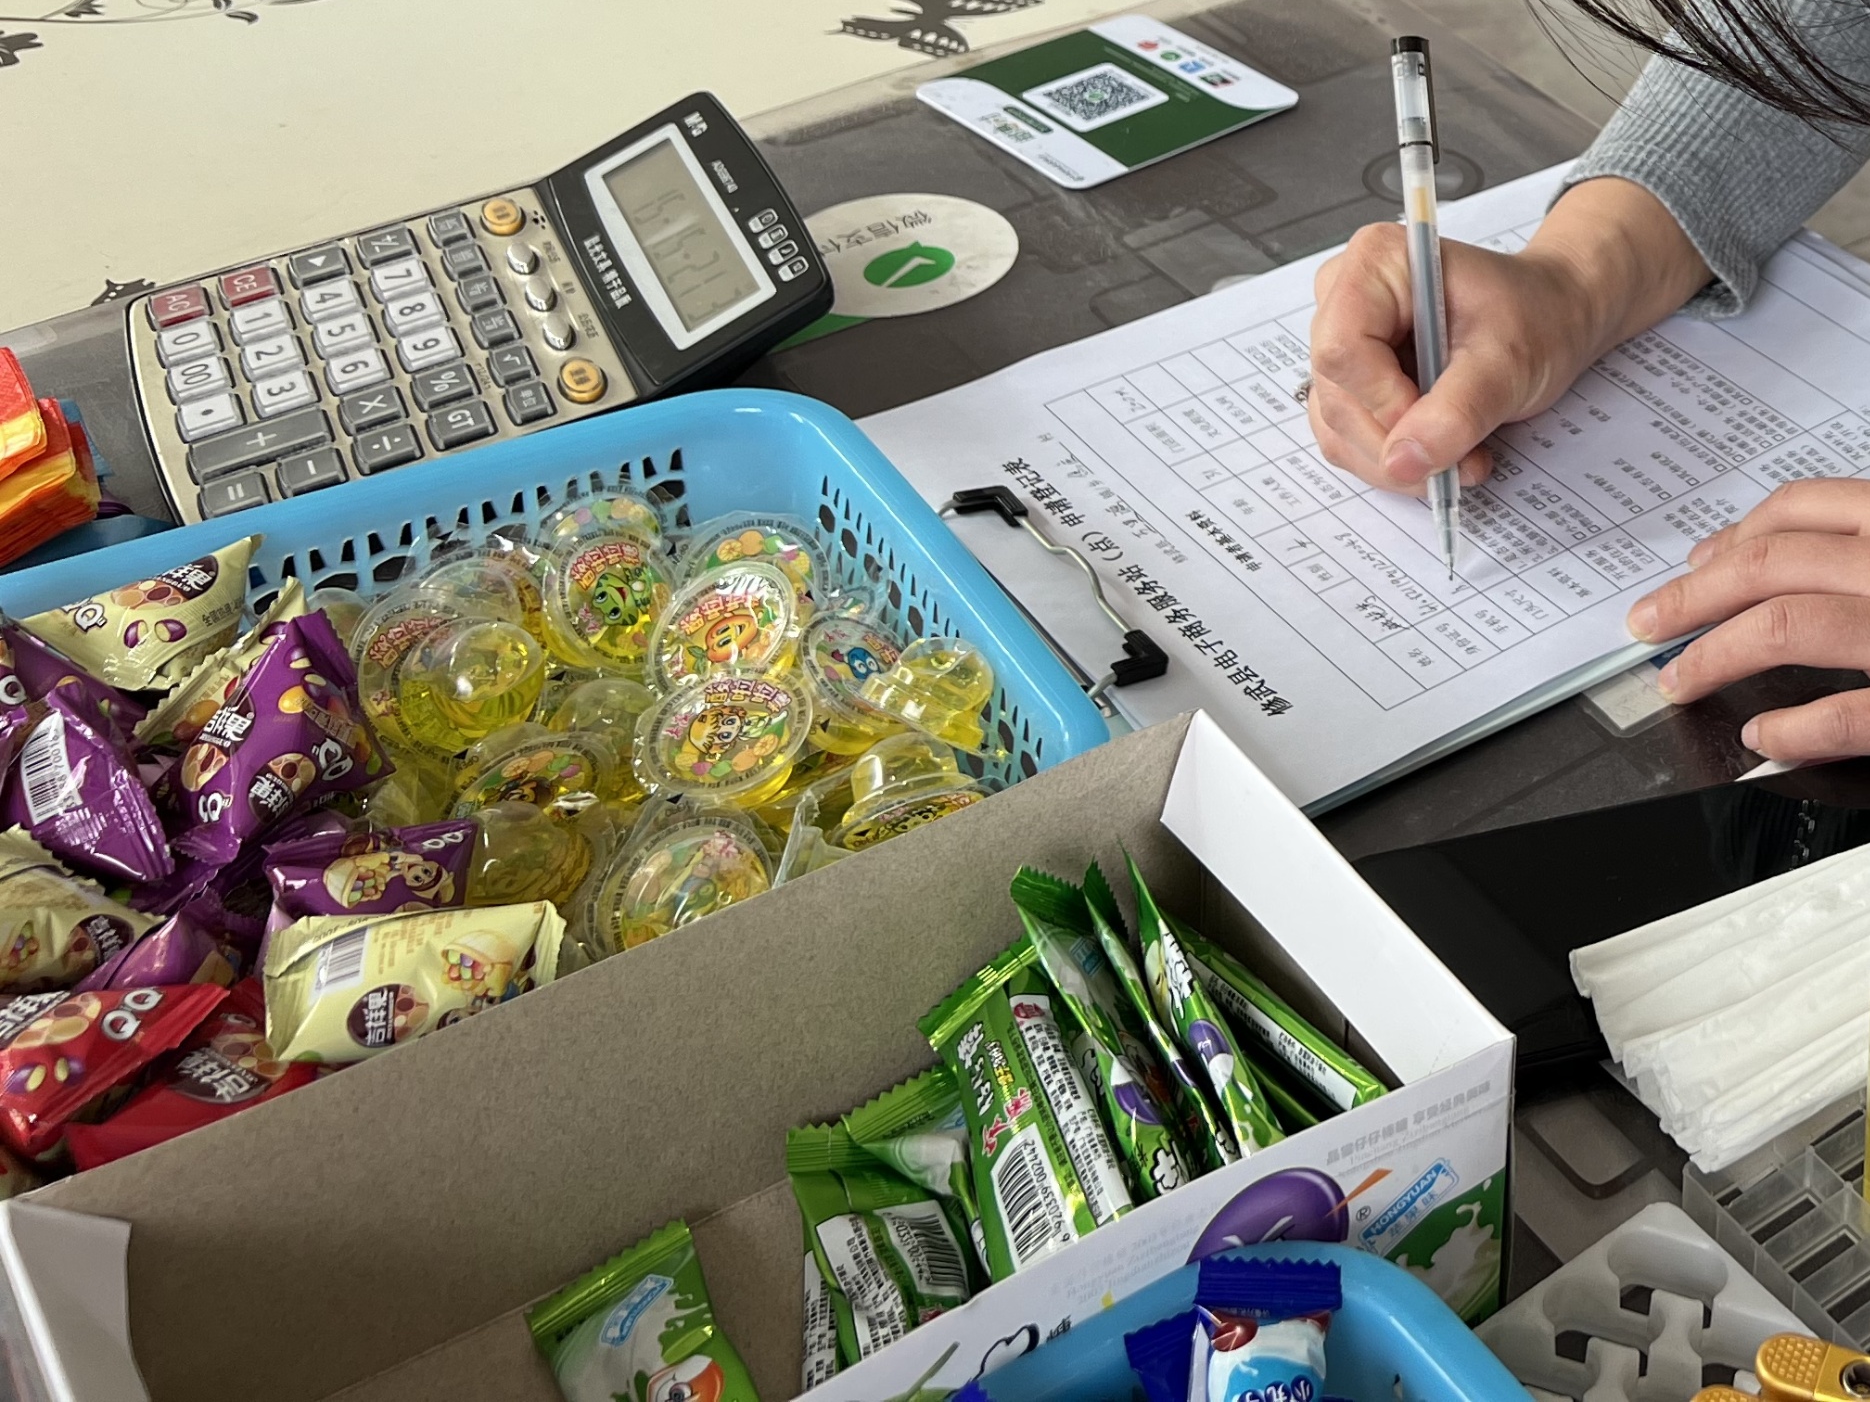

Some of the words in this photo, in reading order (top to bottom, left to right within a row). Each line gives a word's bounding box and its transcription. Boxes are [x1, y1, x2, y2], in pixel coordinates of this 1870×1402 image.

[447, 408, 475, 431] GT
[1648, 418, 1720, 466] 是否有历史故事
[1818, 430, 1866, 460] 其他补充
[1283, 454, 1345, 500] 是否为村干部
[1609, 457, 1664, 493] 是否有景点
[1647, 450, 1692, 480] 其他优势
[1259, 475, 1303, 507] 工作人数
[1581, 469, 1636, 507] 是否有特产
[1183, 507, 1267, 573] 申请者基本资料
[1597, 540, 1644, 573] 站的住所
[1582, 548, 1628, 580] 开设服务
[1546, 565, 1593, 598] 基本资料
[1472, 607, 1510, 634] 手机号
[1502, 587, 1549, 621] 门头尺寸
[1434, 620, 1482, 657] 身份证号
[1405, 646, 1435, 667] 姓名
[102, 987, 165, 1041] QQ
[1371, 1169, 1440, 1234] HONGYUAN
